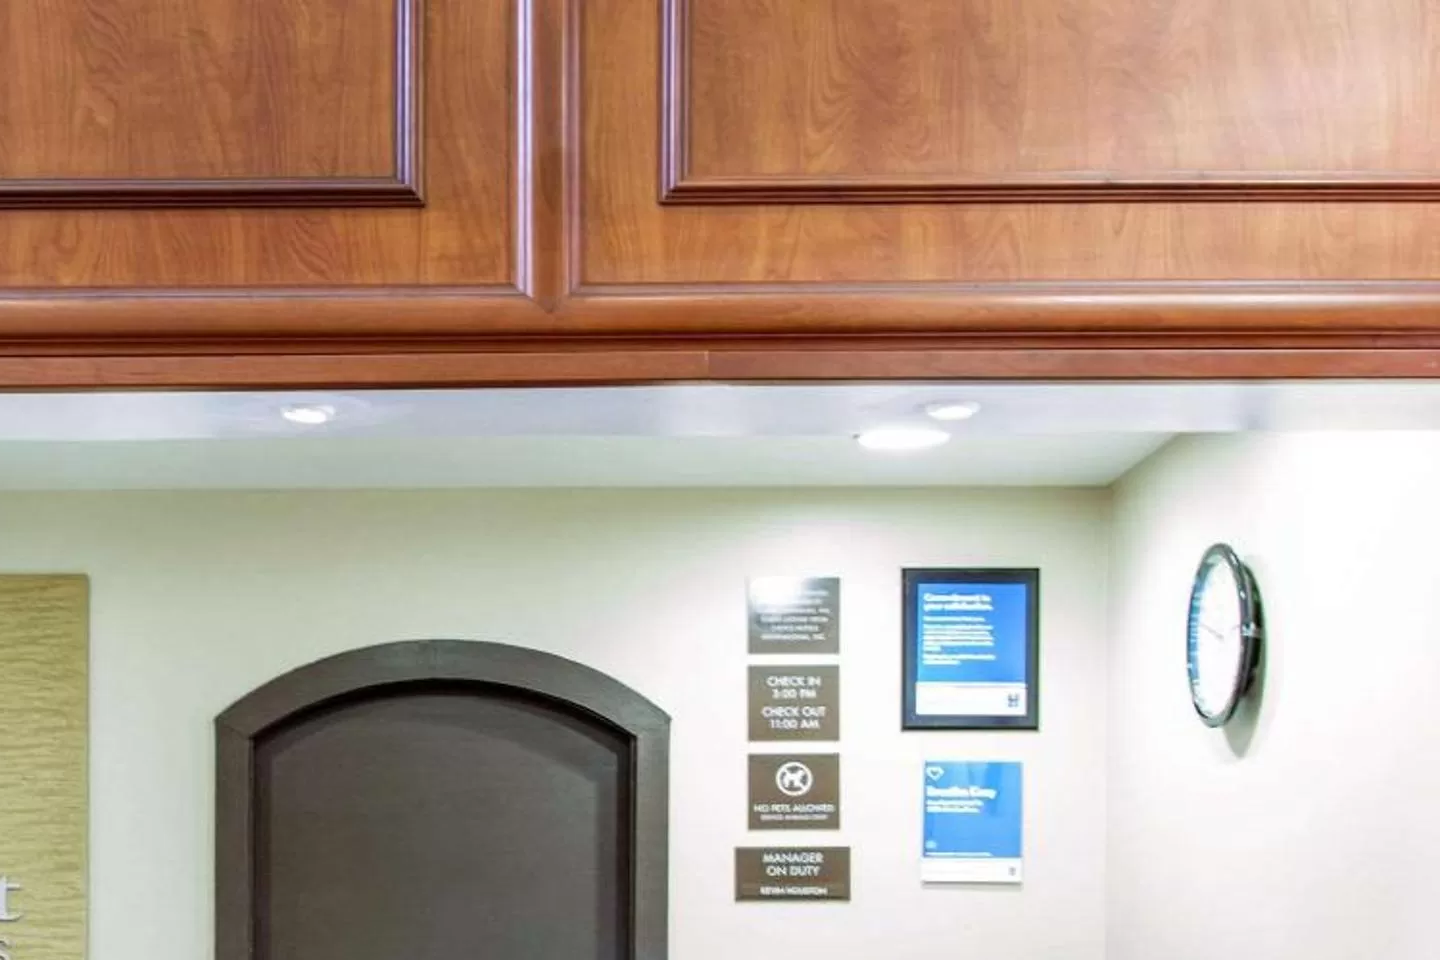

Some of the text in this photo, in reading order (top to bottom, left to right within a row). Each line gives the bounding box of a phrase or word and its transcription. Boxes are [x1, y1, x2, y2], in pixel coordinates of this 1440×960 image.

[765, 675, 822, 687] CHECK IN
[799, 688, 817, 699] PM
[761, 705, 827, 718] CHECK OUT
[800, 718, 820, 729] AM
[753, 803, 770, 813] NO
[762, 851, 824, 863] MANAGER
[765, 865, 820, 877] ON DUTY
